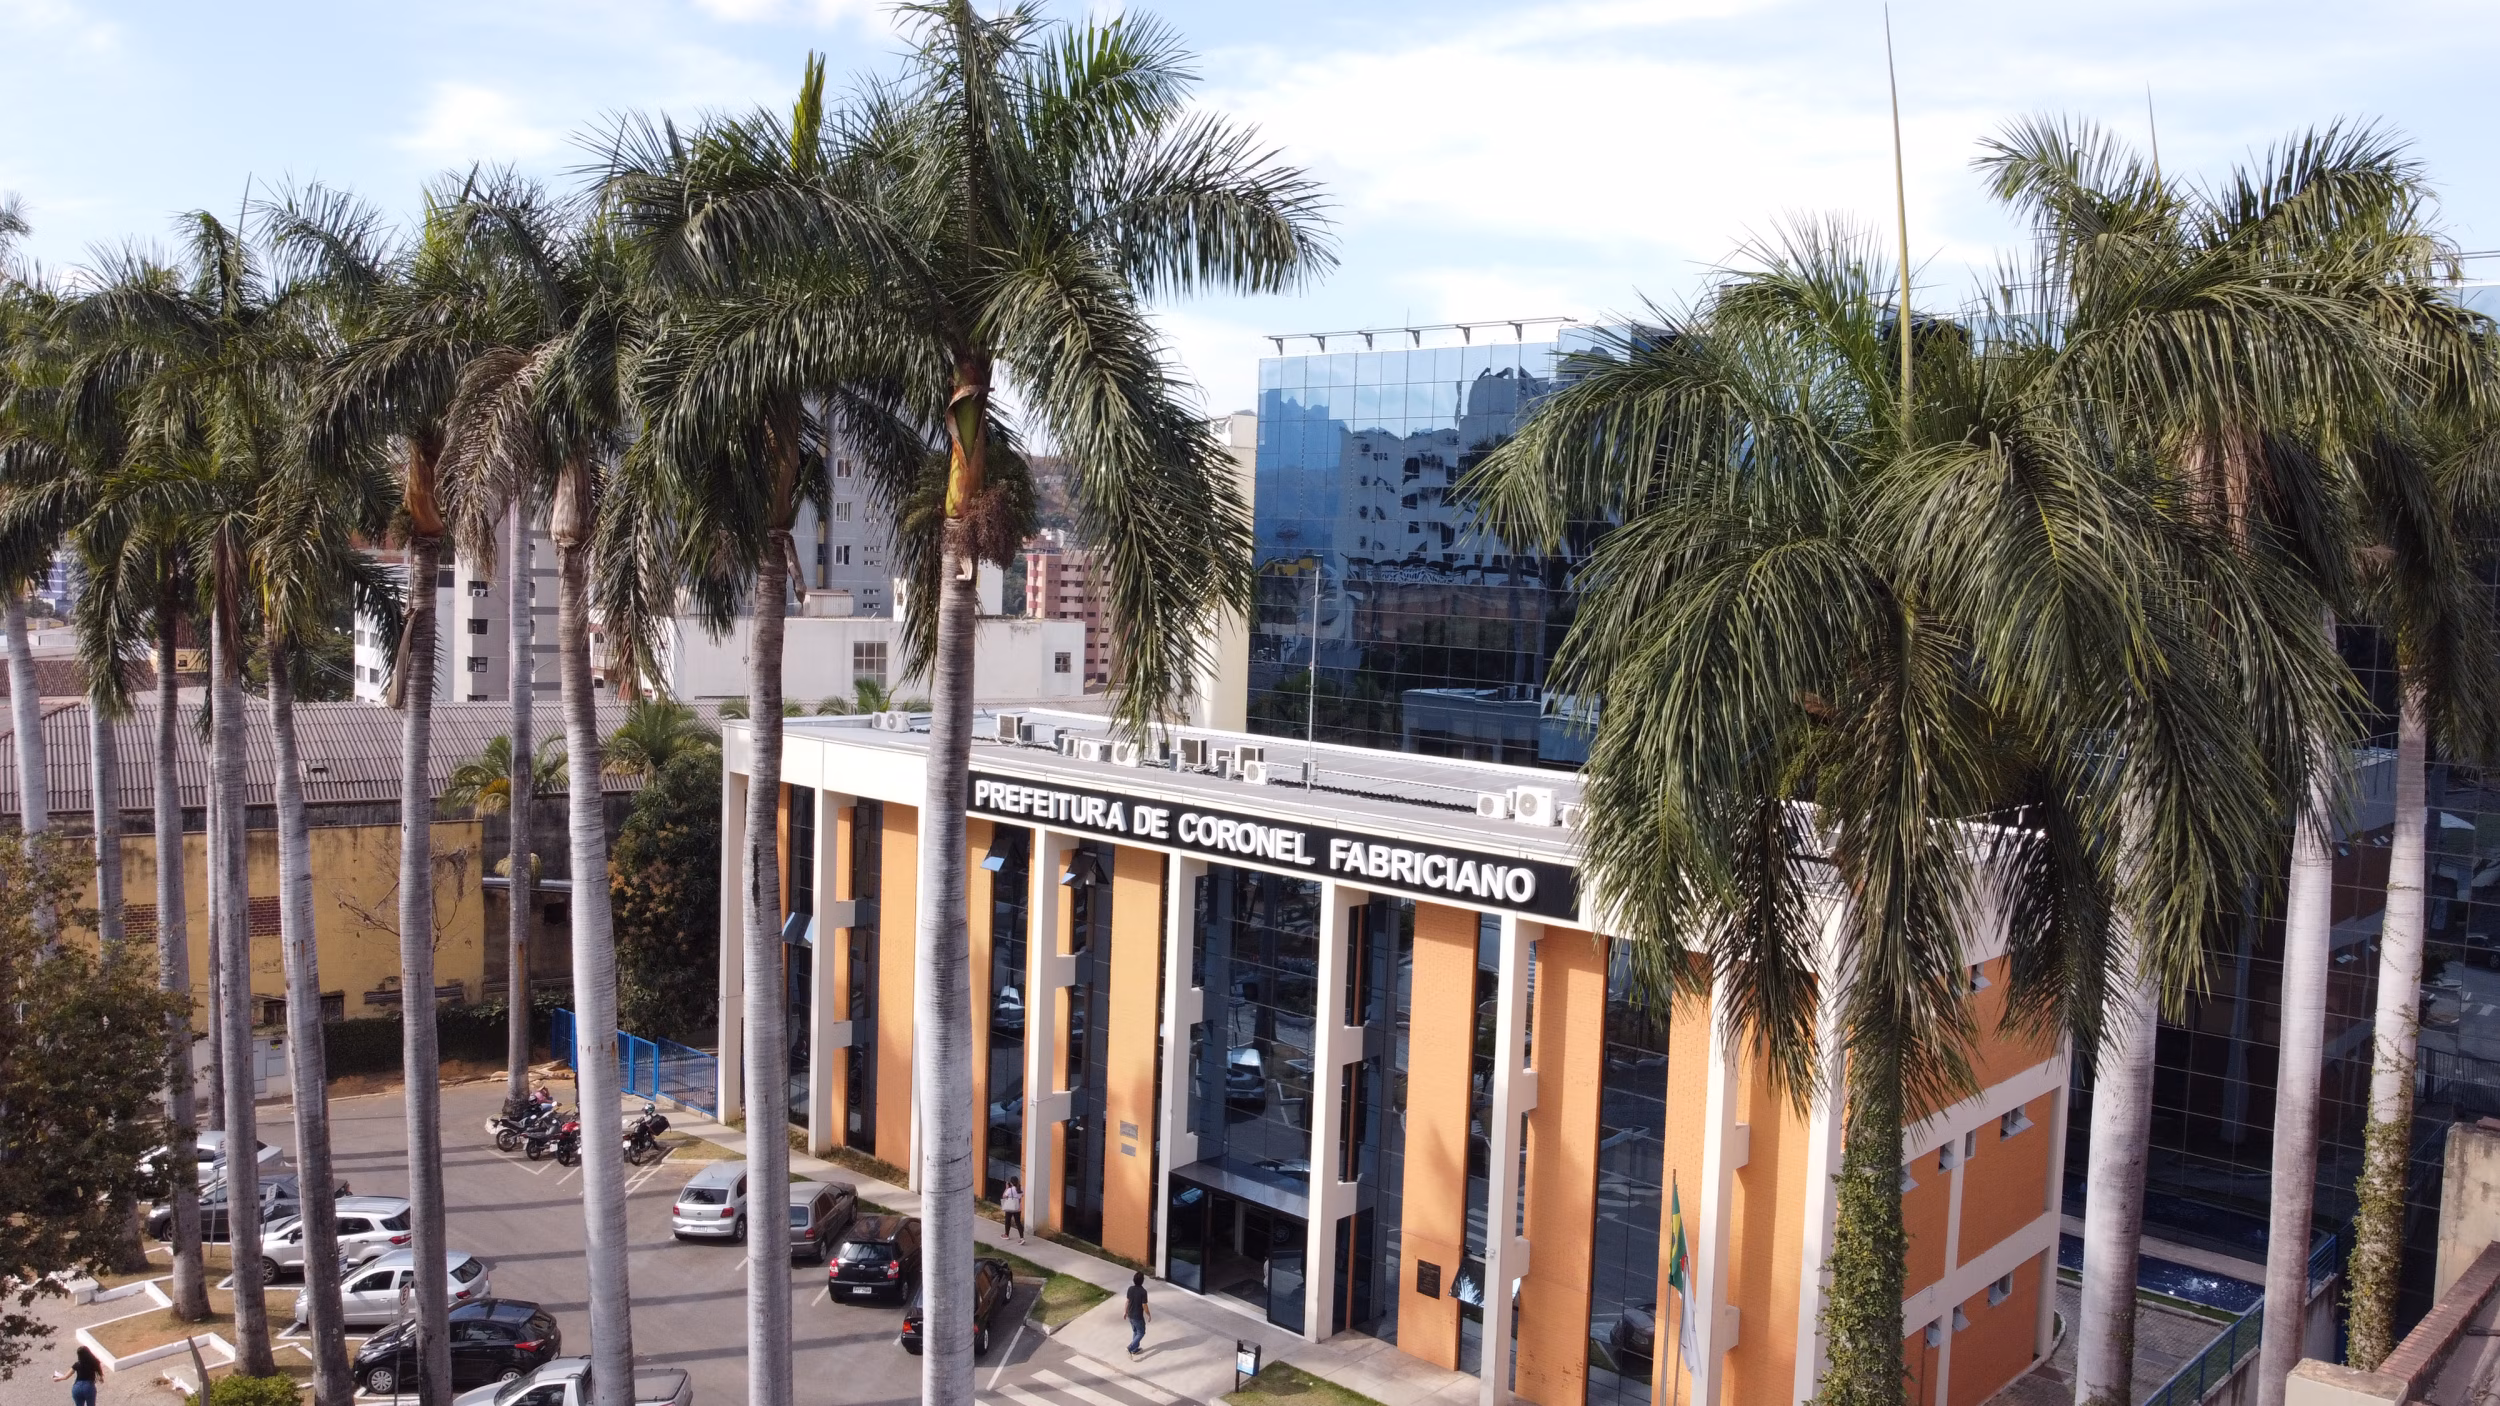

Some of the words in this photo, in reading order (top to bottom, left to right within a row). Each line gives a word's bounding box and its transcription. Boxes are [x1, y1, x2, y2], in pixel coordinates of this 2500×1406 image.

[975, 780, 1127, 831] PREFEITURA
[1133, 805, 1170, 839] DE
[1178, 813, 1315, 866] CORONEL
[1330, 838, 1536, 902] FABRICIANO
